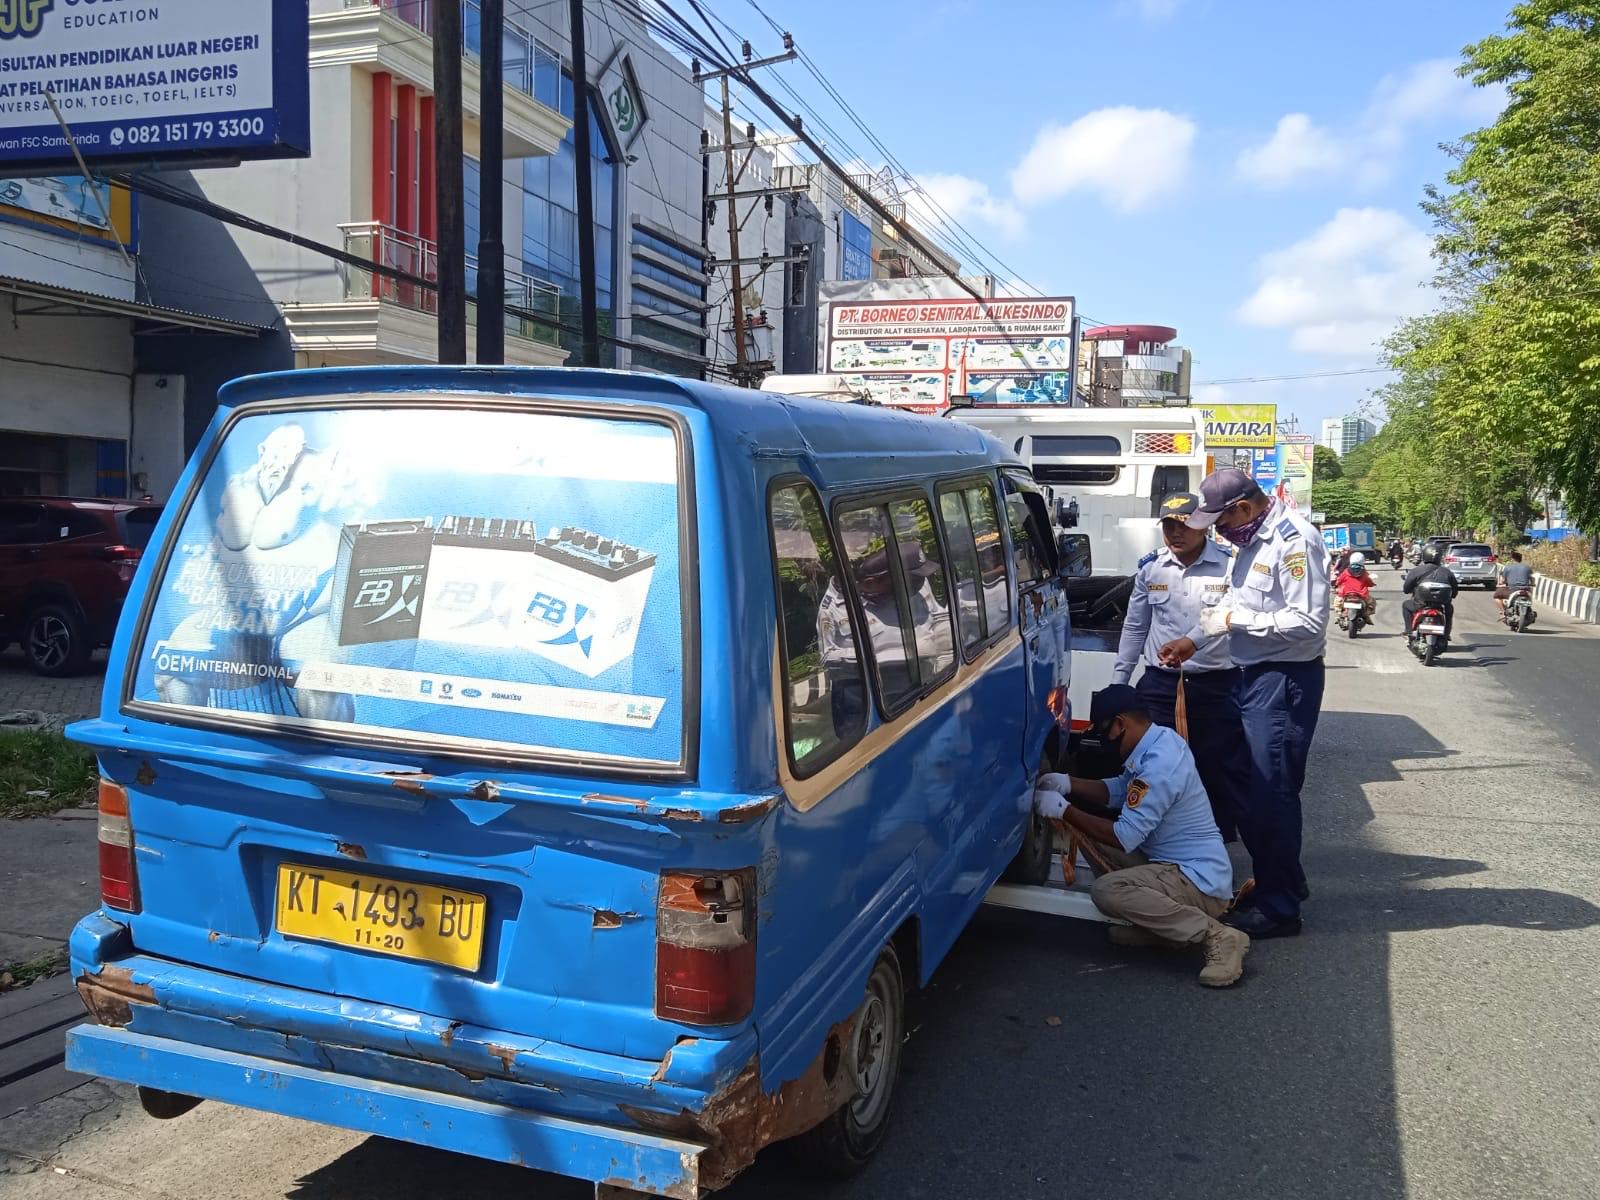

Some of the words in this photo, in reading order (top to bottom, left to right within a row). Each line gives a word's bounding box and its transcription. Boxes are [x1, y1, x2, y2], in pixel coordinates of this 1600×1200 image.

[64, 8, 159, 29] EDUCATION
[0, 54, 57, 73] SULTAN
[60, 45, 153, 67] PENDIDIKAN
[157, 41, 197, 59] LUAR
[201, 34, 259, 54] NEGERI
[20, 76, 101, 96] PELATIHAN
[104, 70, 168, 91] BAHASA
[171, 64, 239, 84] INGGRIS
[91, 94, 139, 108] TOEIC,
[143, 89, 189, 103] TOEFL,
[194, 83, 237, 98] IELTS)
[22, 136, 40, 148] FSC
[127, 125, 160, 144] 082
[165, 123, 188, 141] 151
[192, 121, 214, 140] 79
[218, 117, 264, 138] 3300
[839, 308, 859, 323] PT.
[860, 306, 919, 323] BORNEO
[919, 304, 981, 322] SENTRAL
[983, 303, 1068, 321] ALKESINDO
[837, 327, 883, 336] DISTRIBUTOR
[884, 327, 902, 335] ALAT
[903, 326, 948, 335] KESEHATAN,
[949, 324, 1006, 333] LABORATORIUM
[1007, 324, 1013, 332] &
[1014, 323, 1041, 332] RUMAH
[1043, 323, 1066, 331] SAKIT
[1204, 421, 1272, 436] ANTARA
[188, 585, 302, 612] BATTERY
[354, 579, 394, 605] FB
[195, 606, 282, 635] JAPAN
[526, 591, 568, 625] FB
[157, 653, 194, 674] OEM
[196, 658, 294, 681] INTERNATIONAL
[287, 870, 325, 915] KT
[350, 879, 420, 931] 1493
[438, 894, 475, 942] BU
